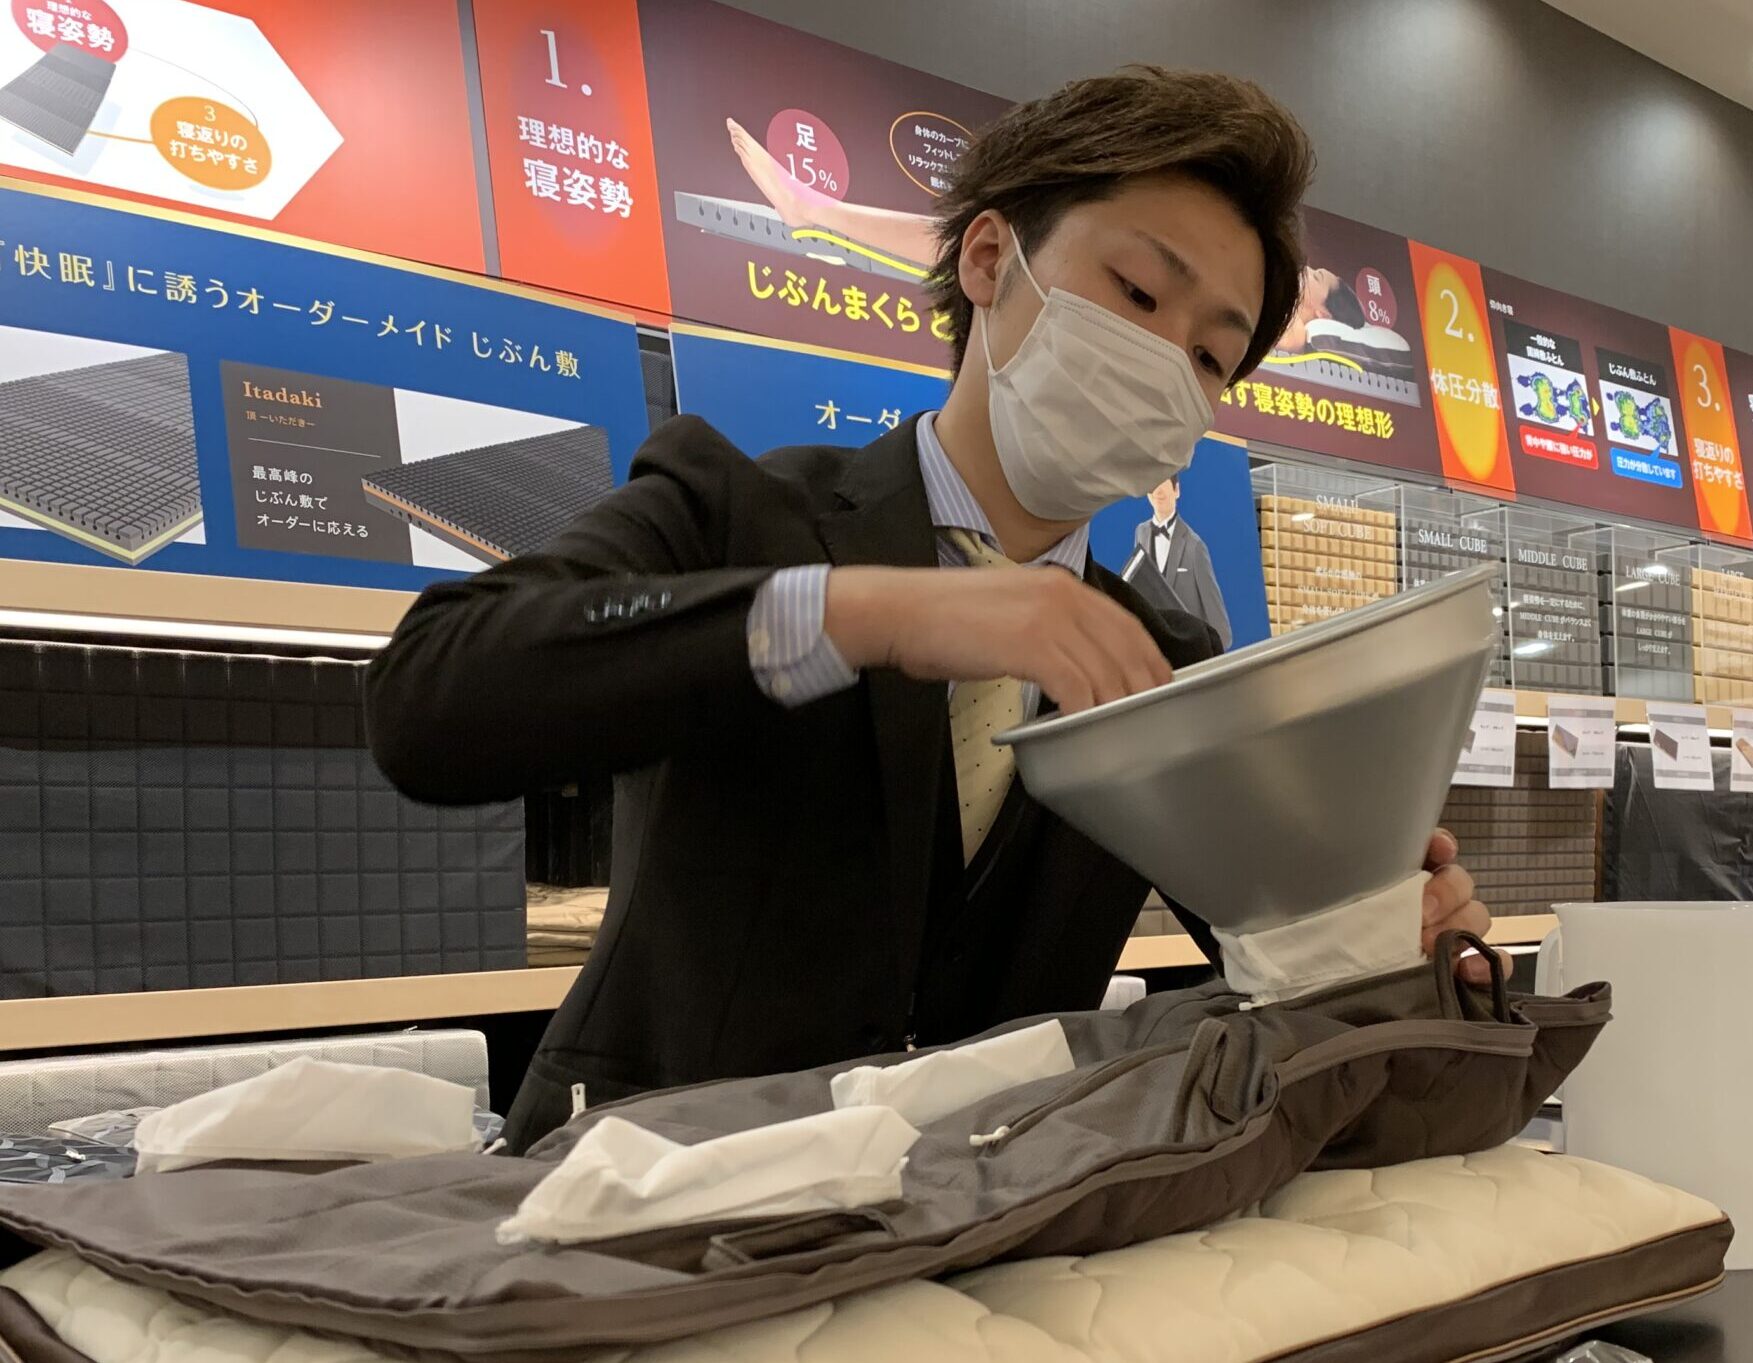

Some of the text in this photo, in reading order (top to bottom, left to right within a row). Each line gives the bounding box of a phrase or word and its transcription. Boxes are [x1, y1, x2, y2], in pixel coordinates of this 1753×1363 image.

[26, 8, 115, 51] 寝姿勢
[540, 29, 592, 96] 1.
[204, 105, 216, 121] 3
[176, 120, 248, 150] 寝返りの
[518, 115, 629, 170] 理想的な
[795, 122, 818, 151] 足
[169, 139, 258, 174] 打ちやすさ
[786, 153, 838, 192] 15%
[523, 158, 634, 218] 寝姿勢
[1366, 275, 1382, 296] 頭
[1368, 300, 1390, 325] 8%
[1440, 289, 1475, 343] 2.
[472, 331, 581, 379] じぶん敷
[243, 380, 323, 409] Itadaki
[1430, 367, 1500, 410] 体圧分散
[1693, 364, 1720, 412] 3.
[252, 465, 314, 486] 最高峰の
[1693, 460, 1744, 491] 打ちやすさ
[255, 489, 329, 511] じぶん敷で
[256, 513, 369, 539] オーダーに応える
[1418, 528, 1488, 554] SMALL CUBE
[1518, 548, 1589, 571] MIDDLE CUBE
